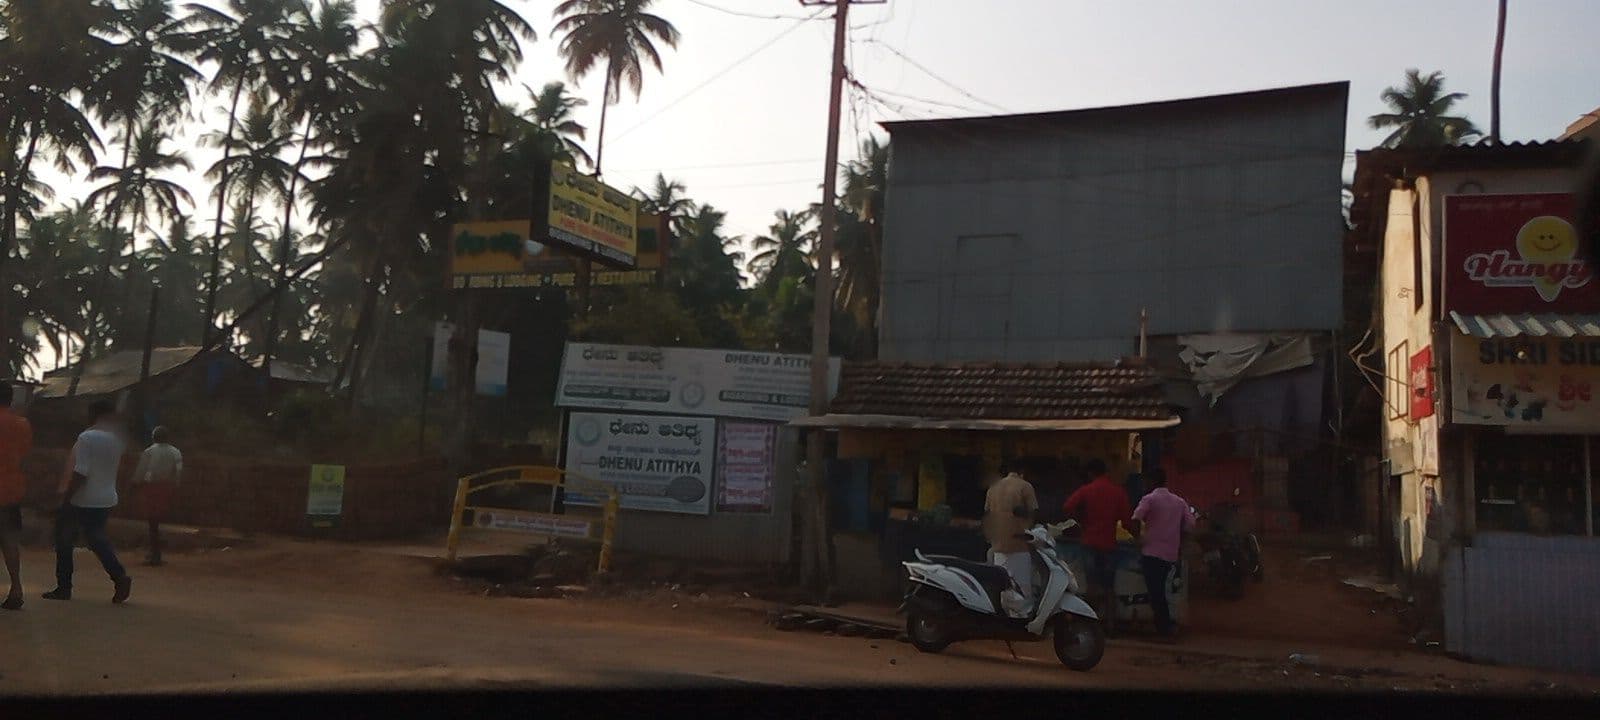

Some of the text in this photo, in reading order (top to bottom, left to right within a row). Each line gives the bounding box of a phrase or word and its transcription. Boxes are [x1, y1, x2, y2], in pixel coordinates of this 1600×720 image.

[724, 352, 769, 366] DHENU
[599, 455, 702, 475] DHENU ATITHYA
